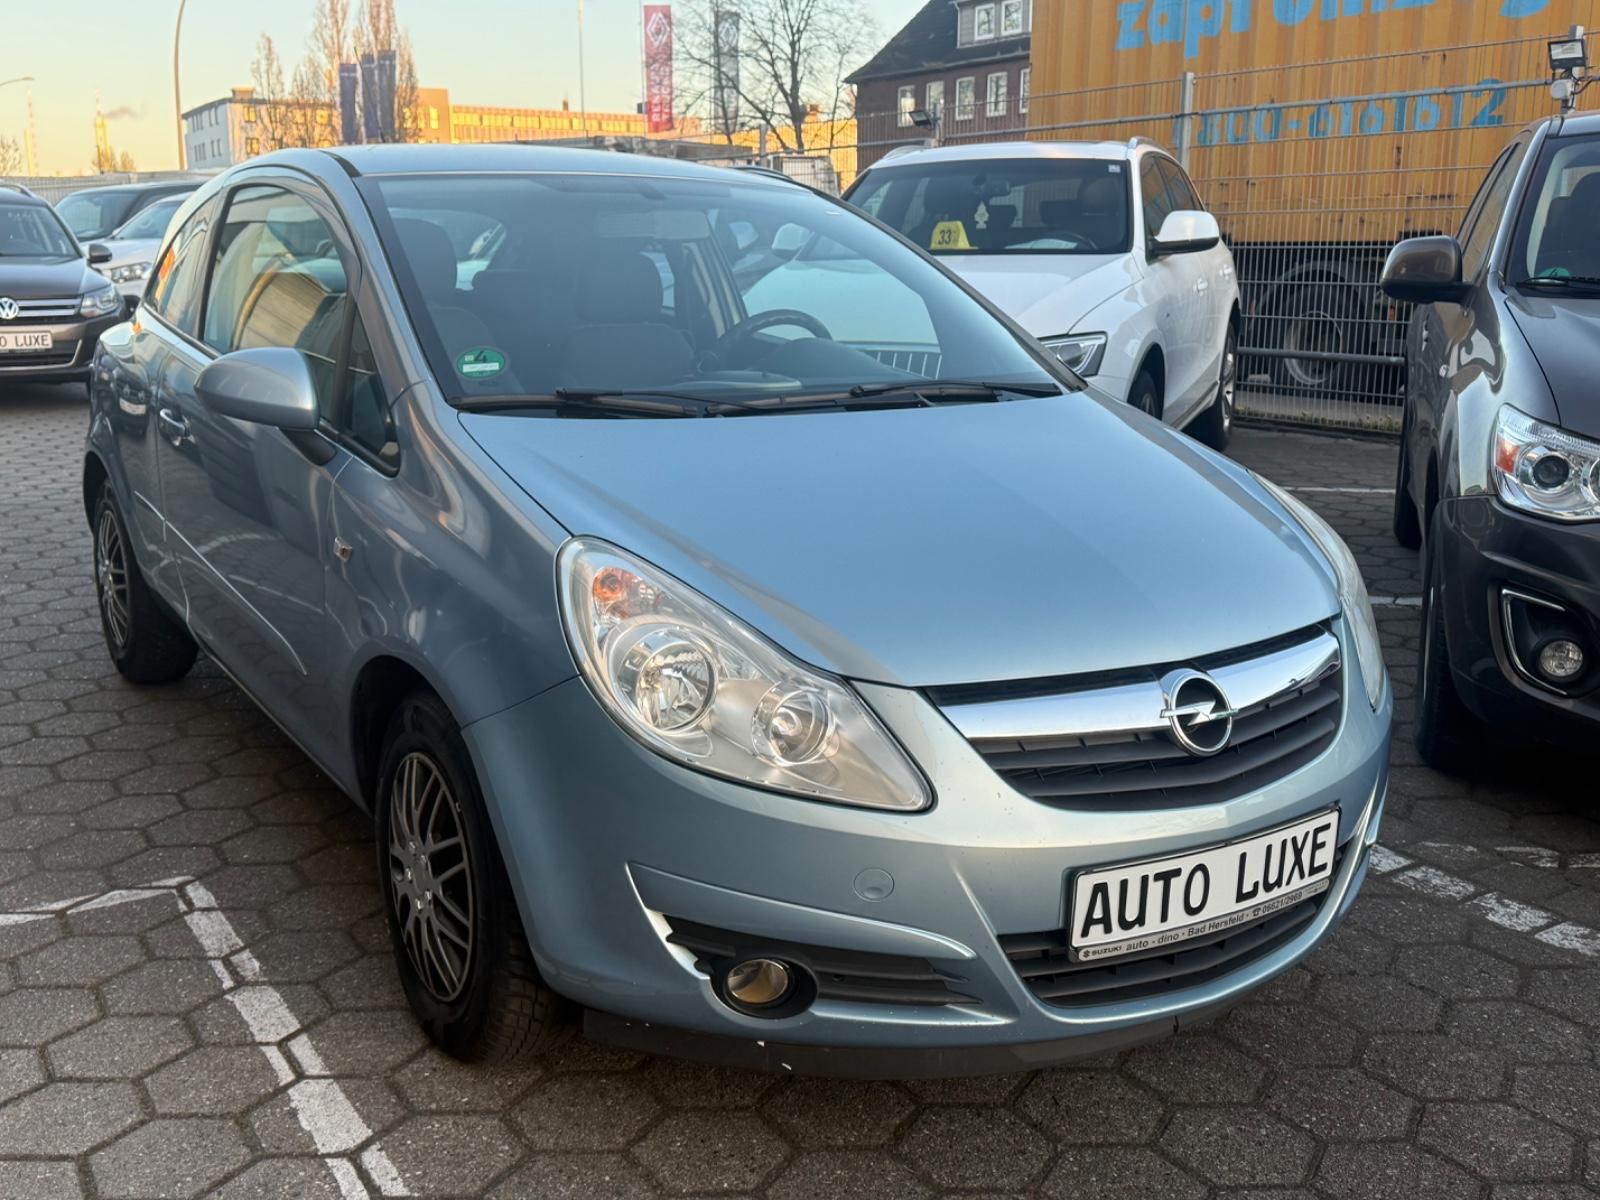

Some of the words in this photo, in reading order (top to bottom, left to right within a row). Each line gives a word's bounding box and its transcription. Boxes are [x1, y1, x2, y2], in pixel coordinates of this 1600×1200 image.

[938, 230, 952, 245] 33
[15, 334, 49, 347] LUXE
[474, 350, 488, 363] 4
[1080, 863, 1211, 939] AUTO
[1235, 823, 1332, 904] LUXE
[1092, 946, 1122, 957] SUZUKI
[1126, 941, 1149, 952] auto
[1157, 933, 1180, 944] dino
[1188, 924, 1206, 937] Bad
[1208, 912, 1245, 932] Hersfeld
